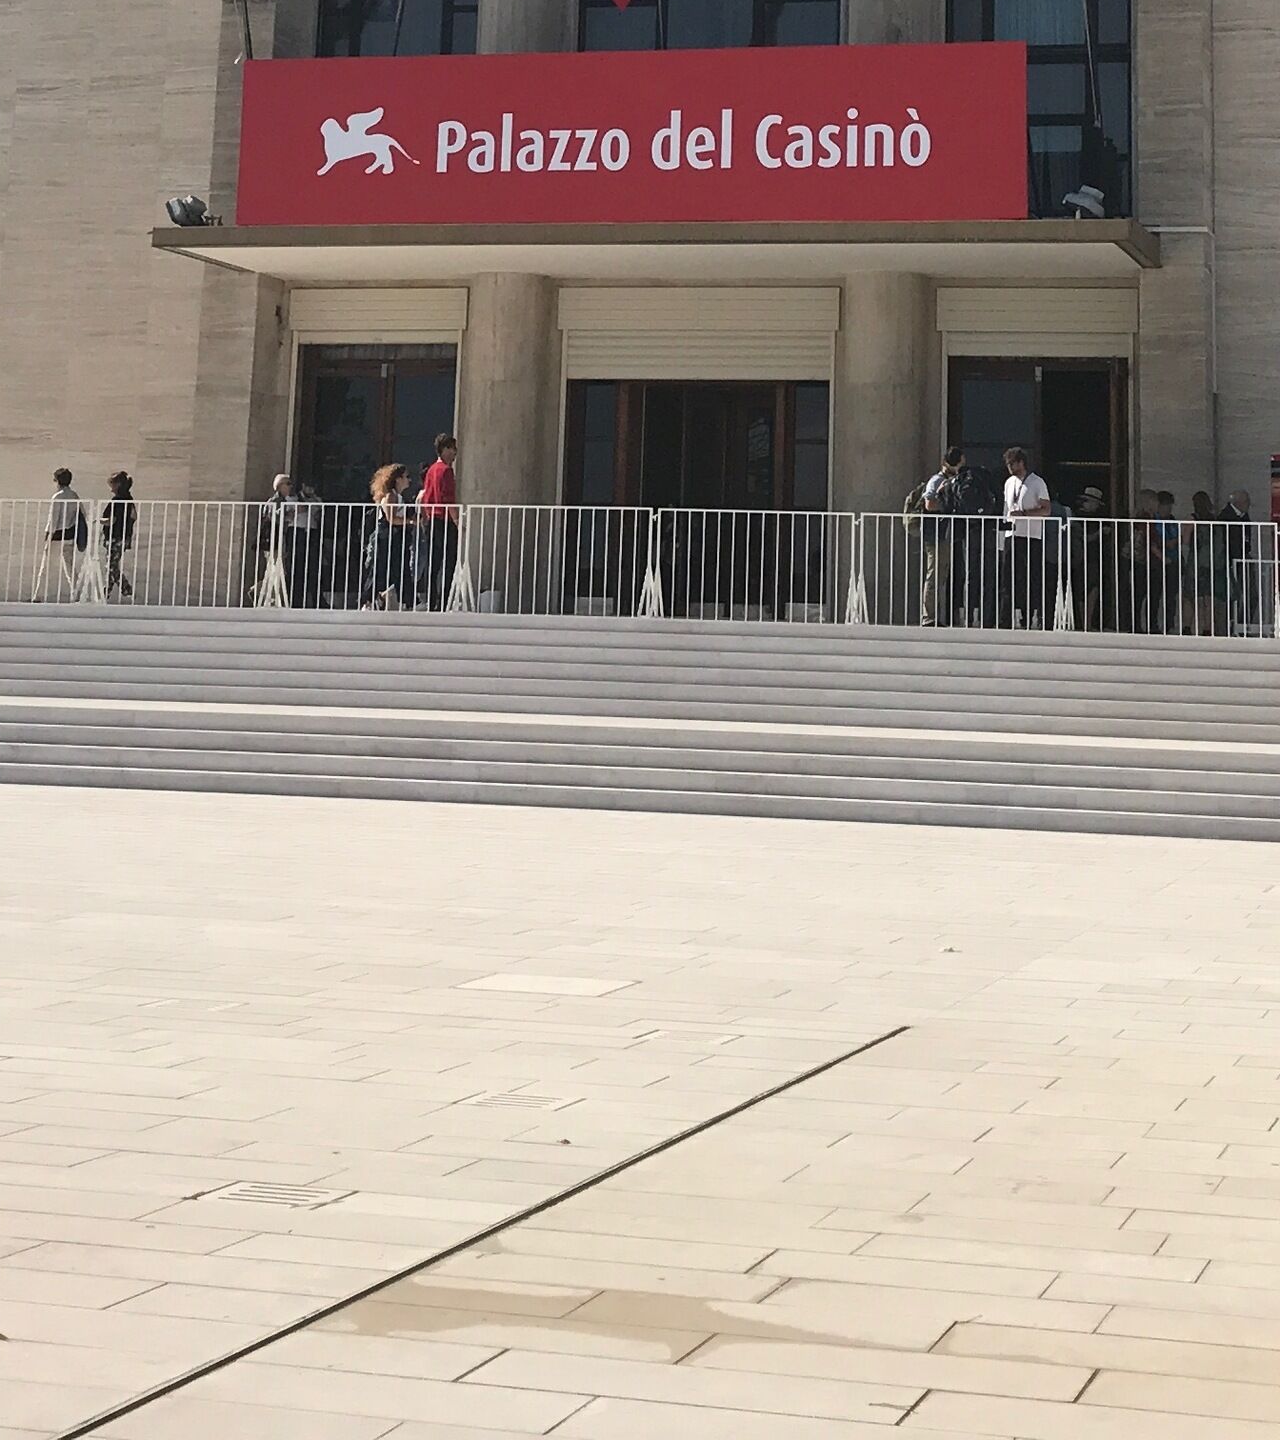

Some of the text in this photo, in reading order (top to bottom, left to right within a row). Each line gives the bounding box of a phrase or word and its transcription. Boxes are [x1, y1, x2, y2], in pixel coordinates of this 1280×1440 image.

[435, 107, 931, 173] Palazzo del Casinò
